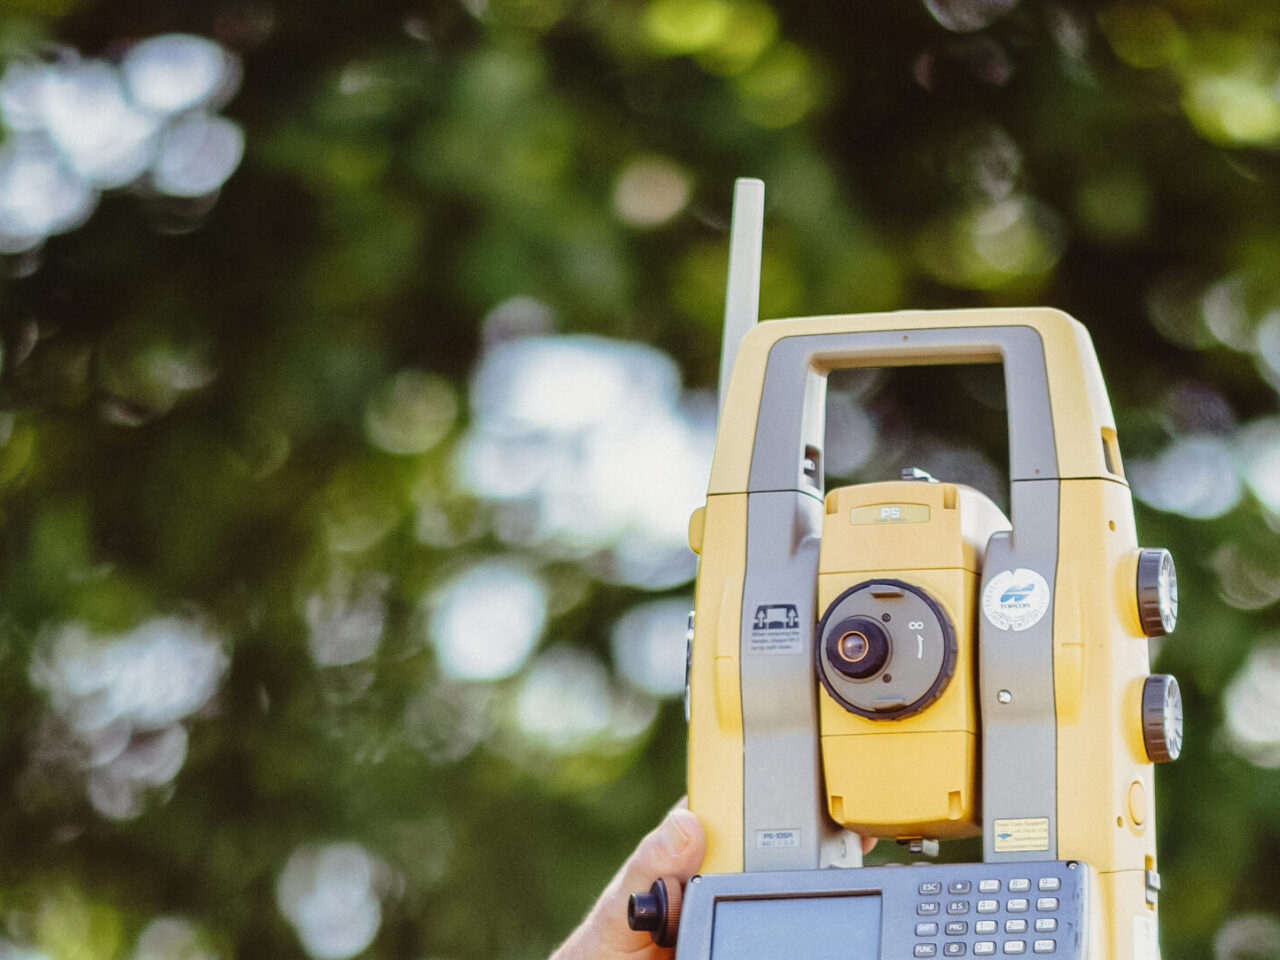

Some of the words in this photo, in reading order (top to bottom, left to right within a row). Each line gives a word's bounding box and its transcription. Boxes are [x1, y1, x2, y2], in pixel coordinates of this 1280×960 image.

[881, 507, 900, 520] PS
[923, 883, 937, 891] ESC
[921, 903, 935, 911] TAB
[917, 923, 935, 932] SHIFT
[948, 923, 963, 931] PRG
[916, 945, 933, 954] FUNC
